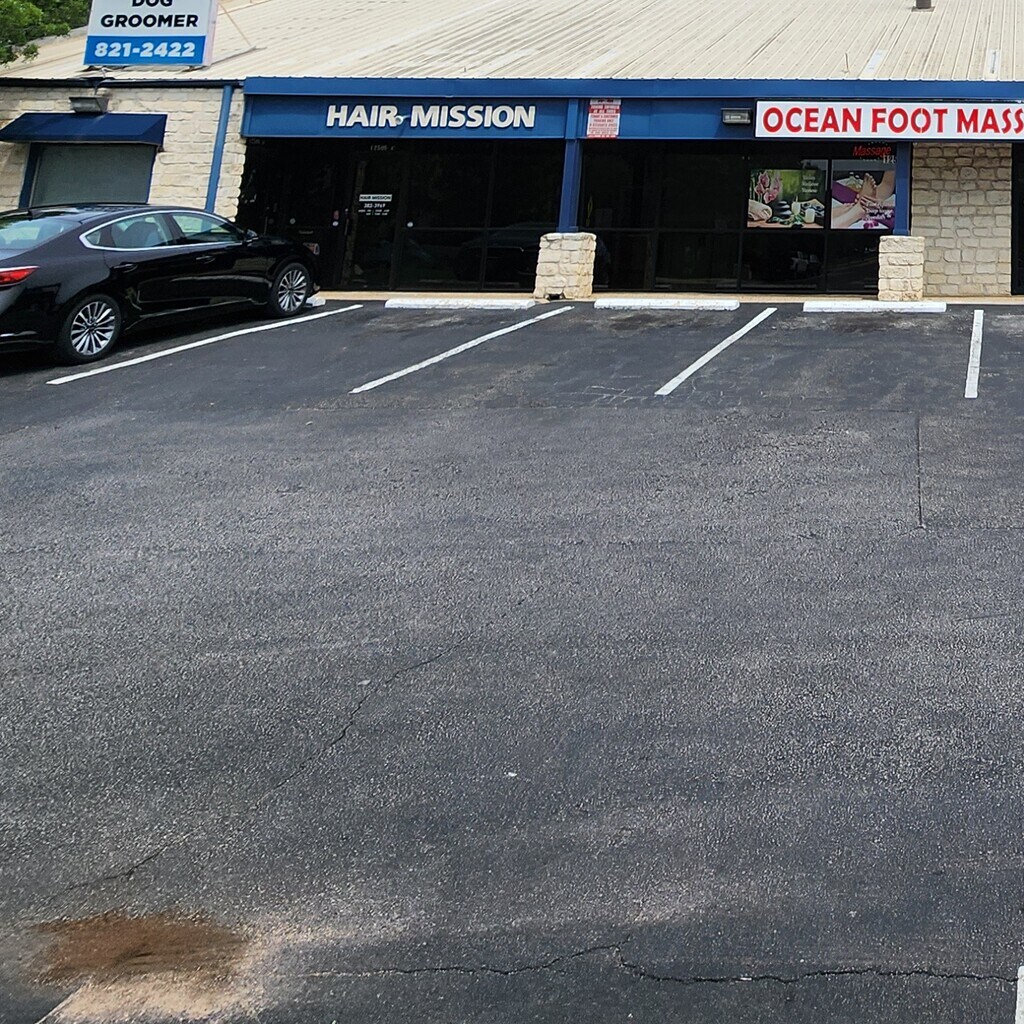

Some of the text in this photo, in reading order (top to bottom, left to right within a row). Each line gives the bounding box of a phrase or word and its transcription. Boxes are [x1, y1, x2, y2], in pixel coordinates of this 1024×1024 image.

[100, 14, 199, 28] GROOMER
[94, 42, 196, 57] 821-2422
[326, 105, 536, 127] HAIR MISSION
[762, 106, 863, 134] OCEAN
[870, 107, 949, 134] FOOT
[852, 145, 892, 159] Massage
